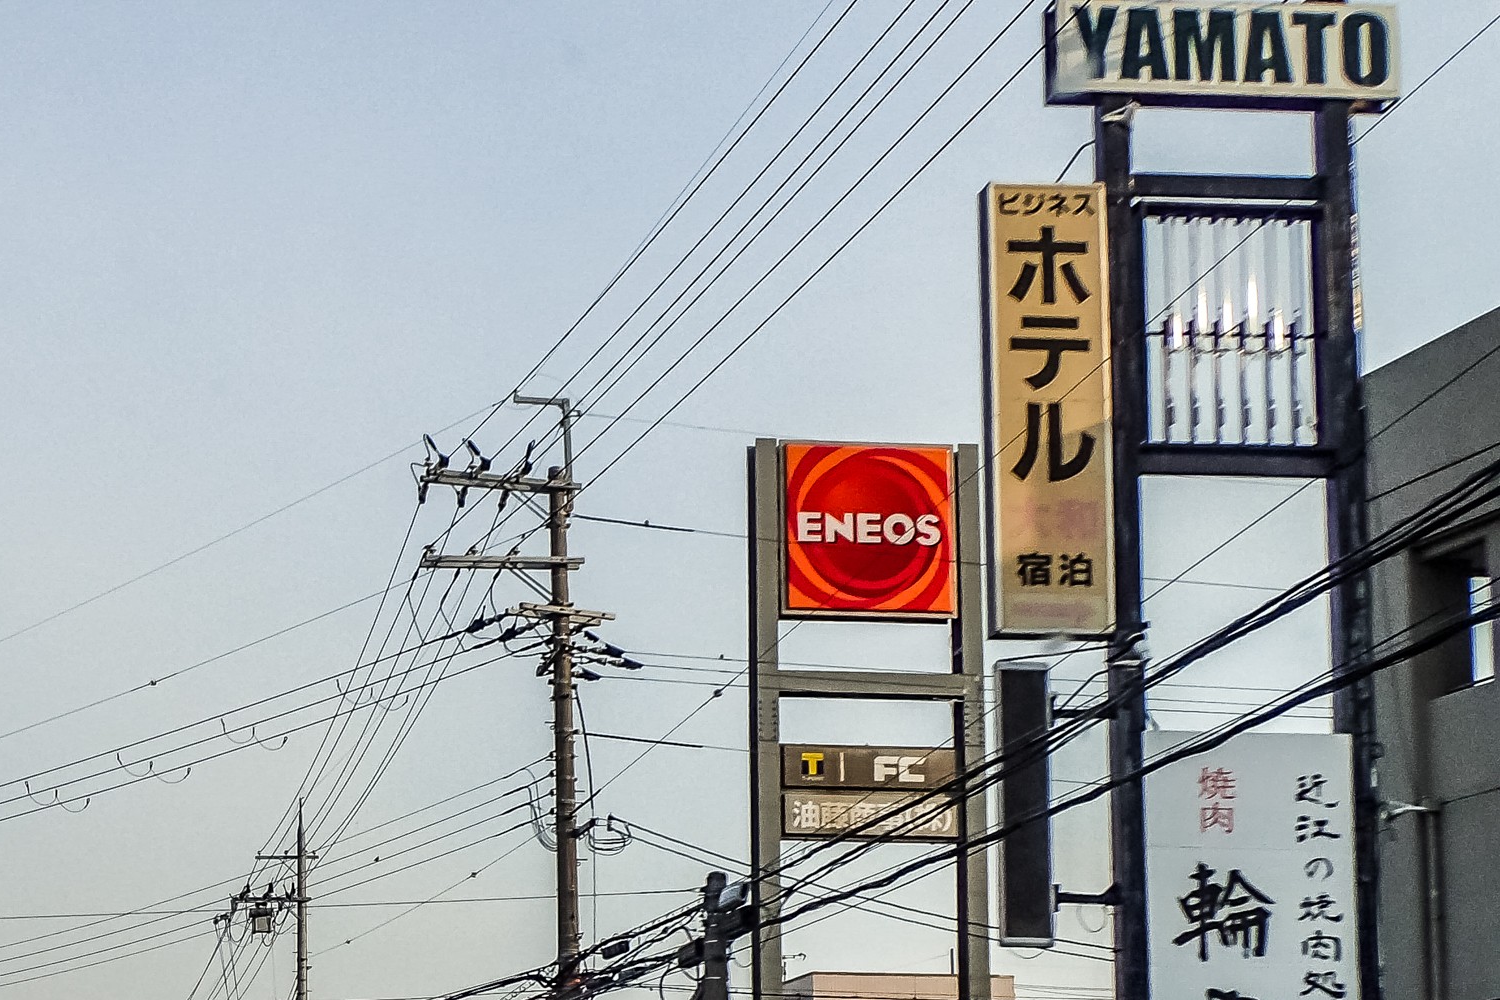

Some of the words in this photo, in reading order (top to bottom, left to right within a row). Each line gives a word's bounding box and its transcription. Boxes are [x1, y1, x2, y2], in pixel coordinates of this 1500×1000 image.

[1071, 7, 1391, 88] YAMATO
[998, 192, 1096, 217] ビジネス
[1007, 227, 1095, 484] ホテル
[796, 511, 941, 546] ENEOS
[1017, 553, 1093, 588] 宿泊
[1197, 766, 1237, 834] 焼肉
